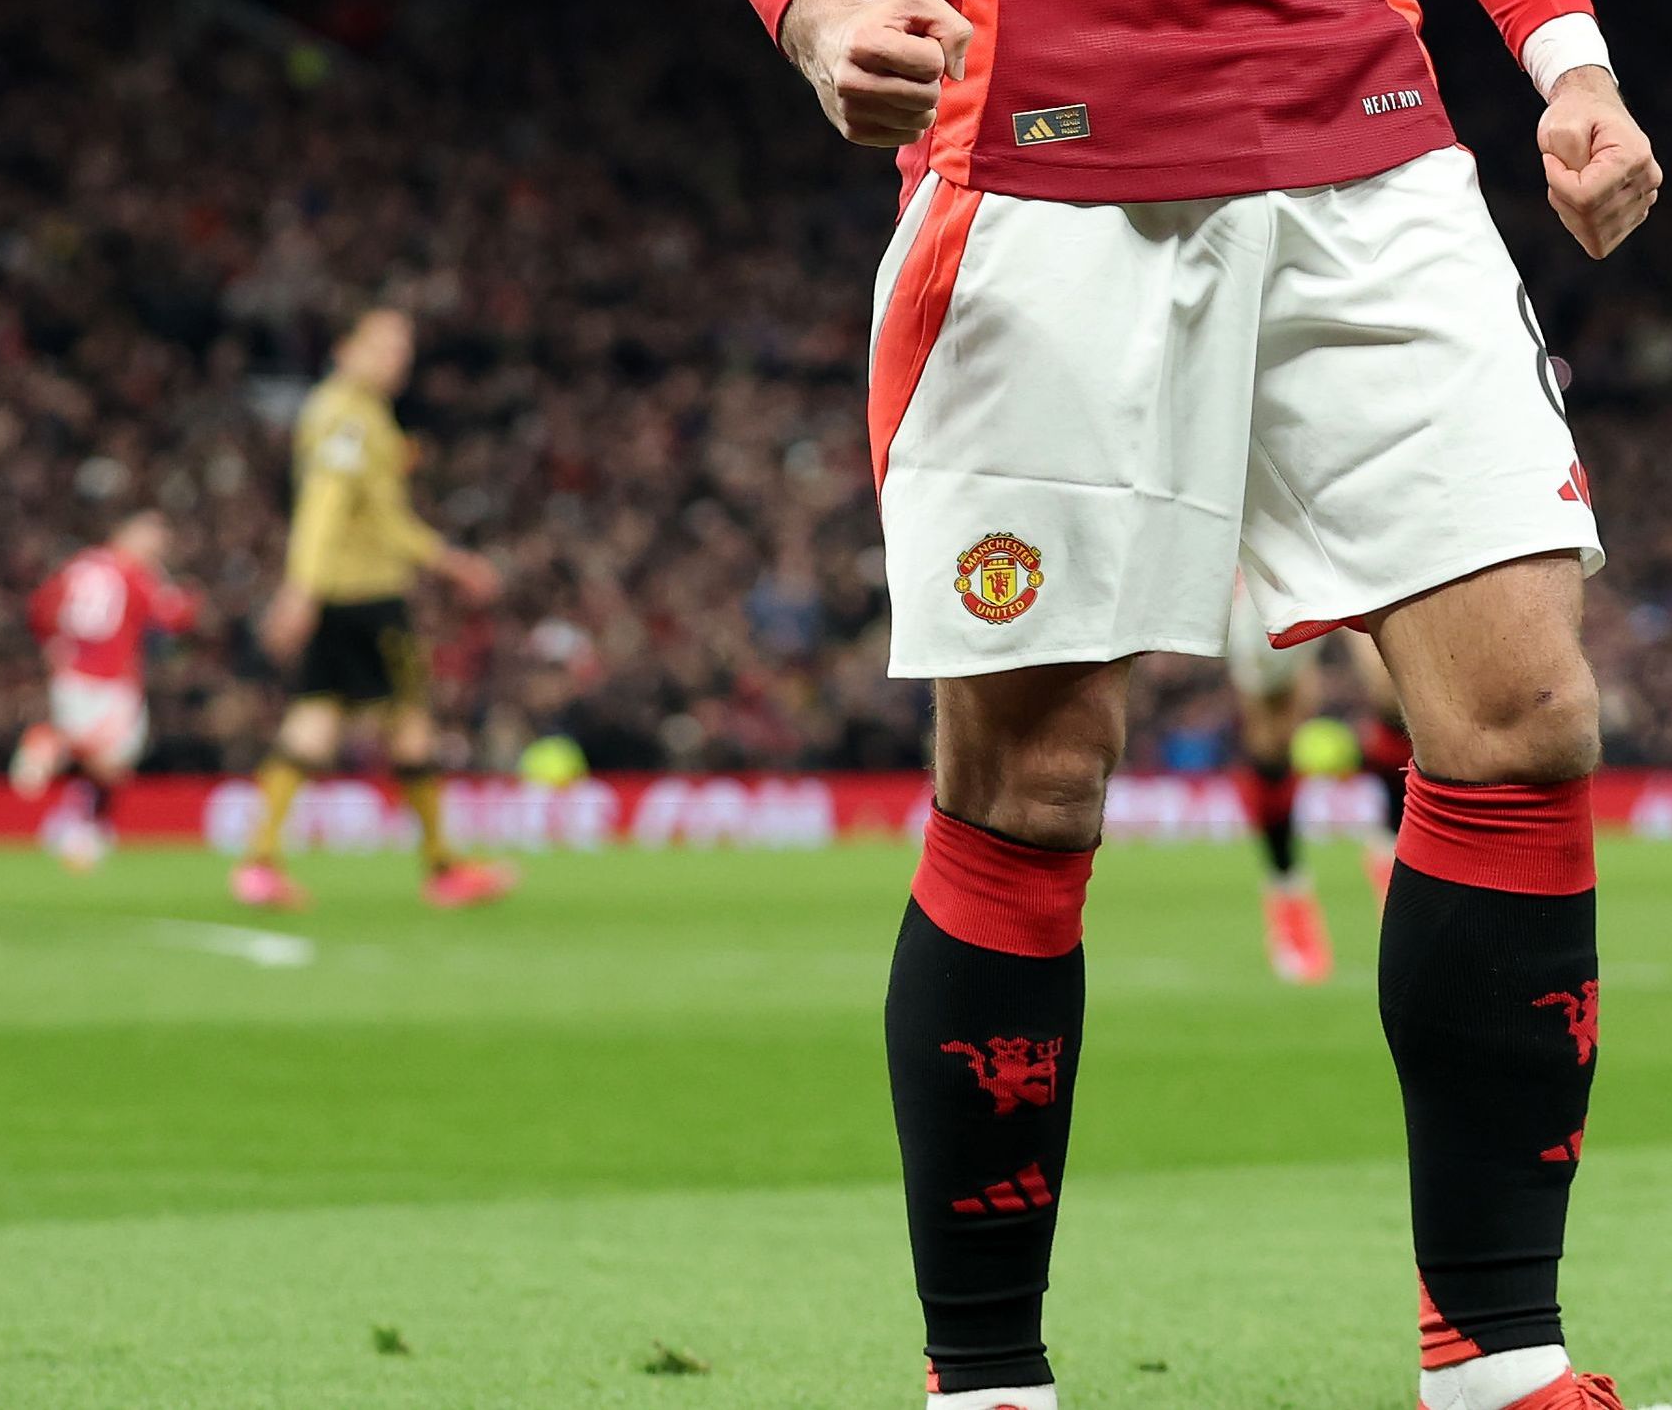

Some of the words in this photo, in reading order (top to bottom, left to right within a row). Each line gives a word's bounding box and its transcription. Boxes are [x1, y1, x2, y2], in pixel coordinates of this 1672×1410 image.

[1361, 89, 1423, 116] HEAT.RDY
[963, 539, 1035, 570] MANCHESTER
[976, 600, 1026, 618] UNITED
